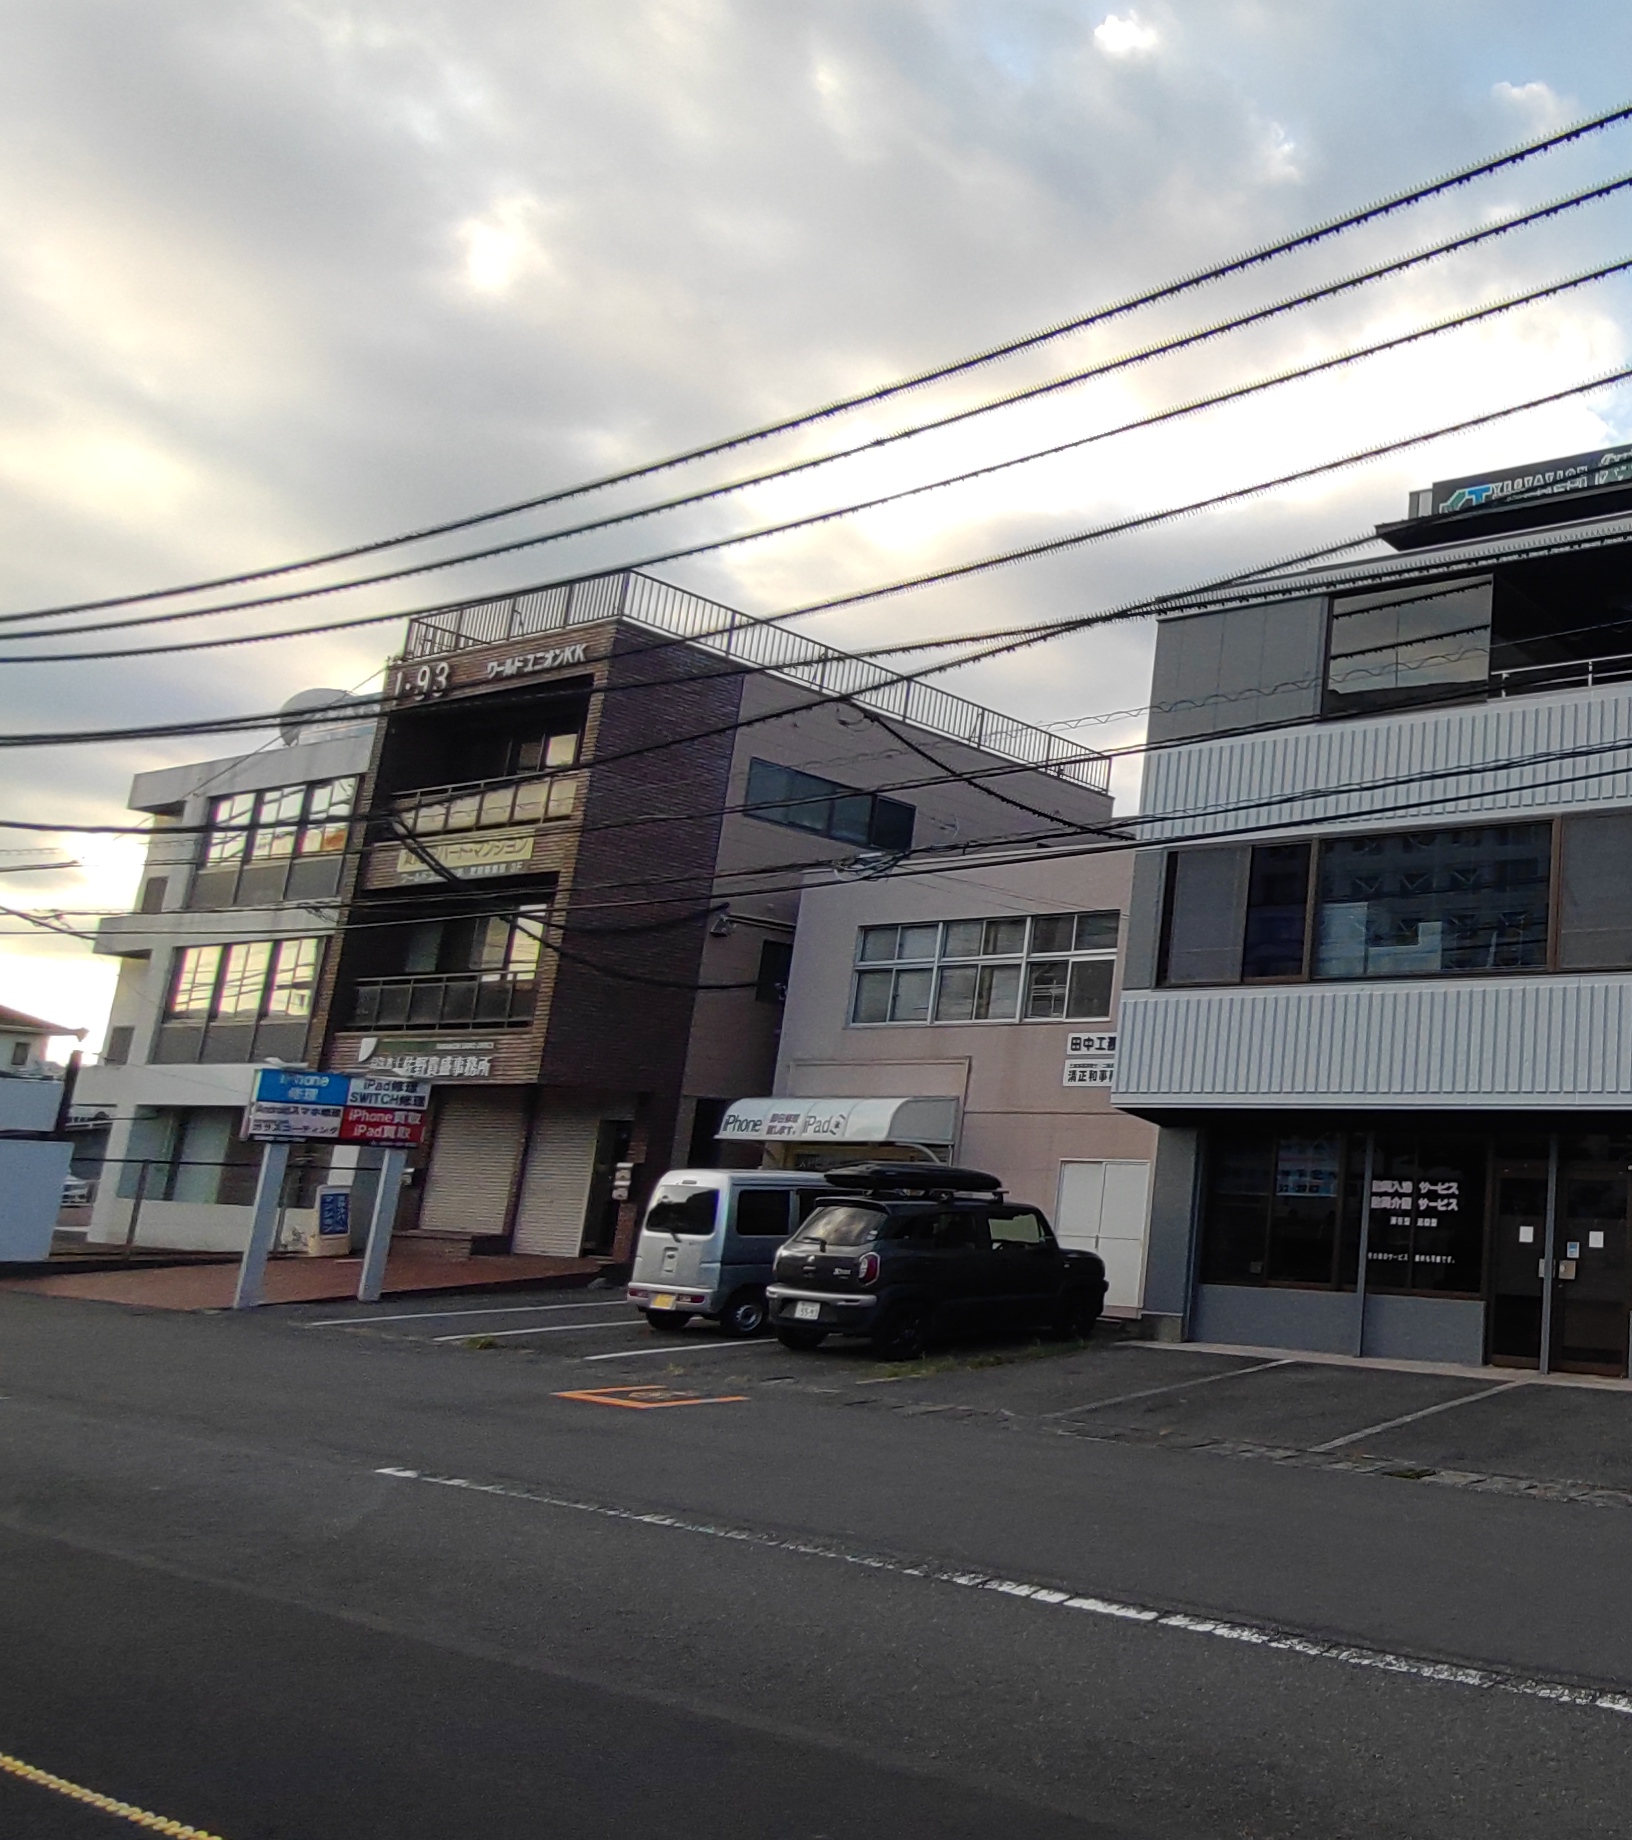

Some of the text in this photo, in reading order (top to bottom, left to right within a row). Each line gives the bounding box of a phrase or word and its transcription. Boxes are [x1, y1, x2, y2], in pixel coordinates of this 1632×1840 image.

[722, 1114, 763, 1133] iPhone
[802, 1115, 833, 1134] iPad
[1418, 1181, 1460, 1195] サービス
[1417, 1197, 1459, 1212] サービス
